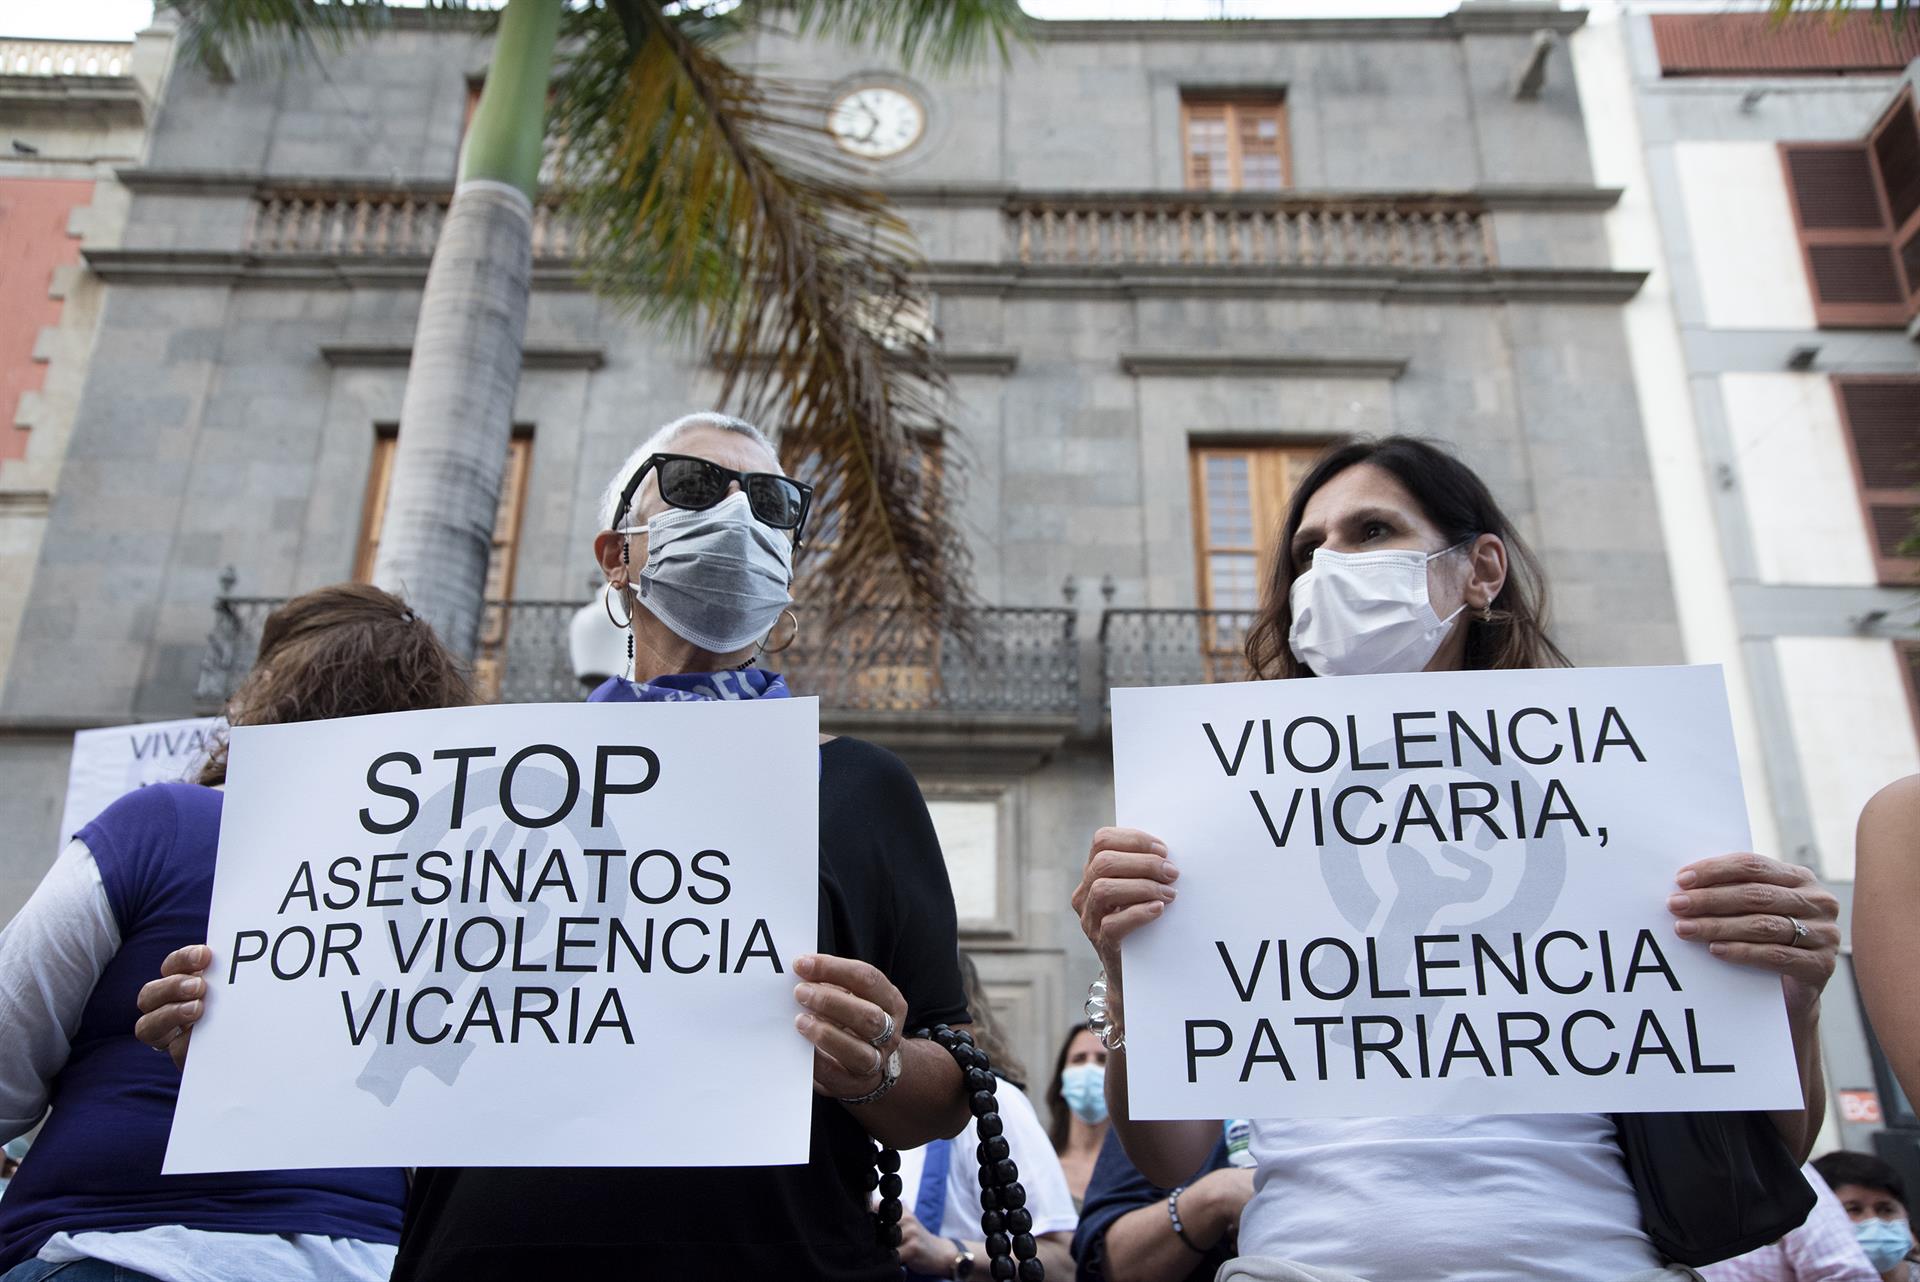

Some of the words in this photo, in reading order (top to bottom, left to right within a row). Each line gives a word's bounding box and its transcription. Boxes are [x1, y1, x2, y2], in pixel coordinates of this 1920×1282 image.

[1200, 705, 1648, 778] VIOLENCIA
[358, 742, 662, 836] STOP
[1248, 777, 1610, 849] VICARIA,
[276, 847, 733, 916] ASESINATOS
[227, 921, 364, 986] POR
[386, 914, 786, 976] VIOLENCIA
[1213, 927, 1684, 1004] VIOLENCIA
[339, 985, 636, 1047] VICARIA
[1183, 1007, 1737, 1084] PATRIARCAL
